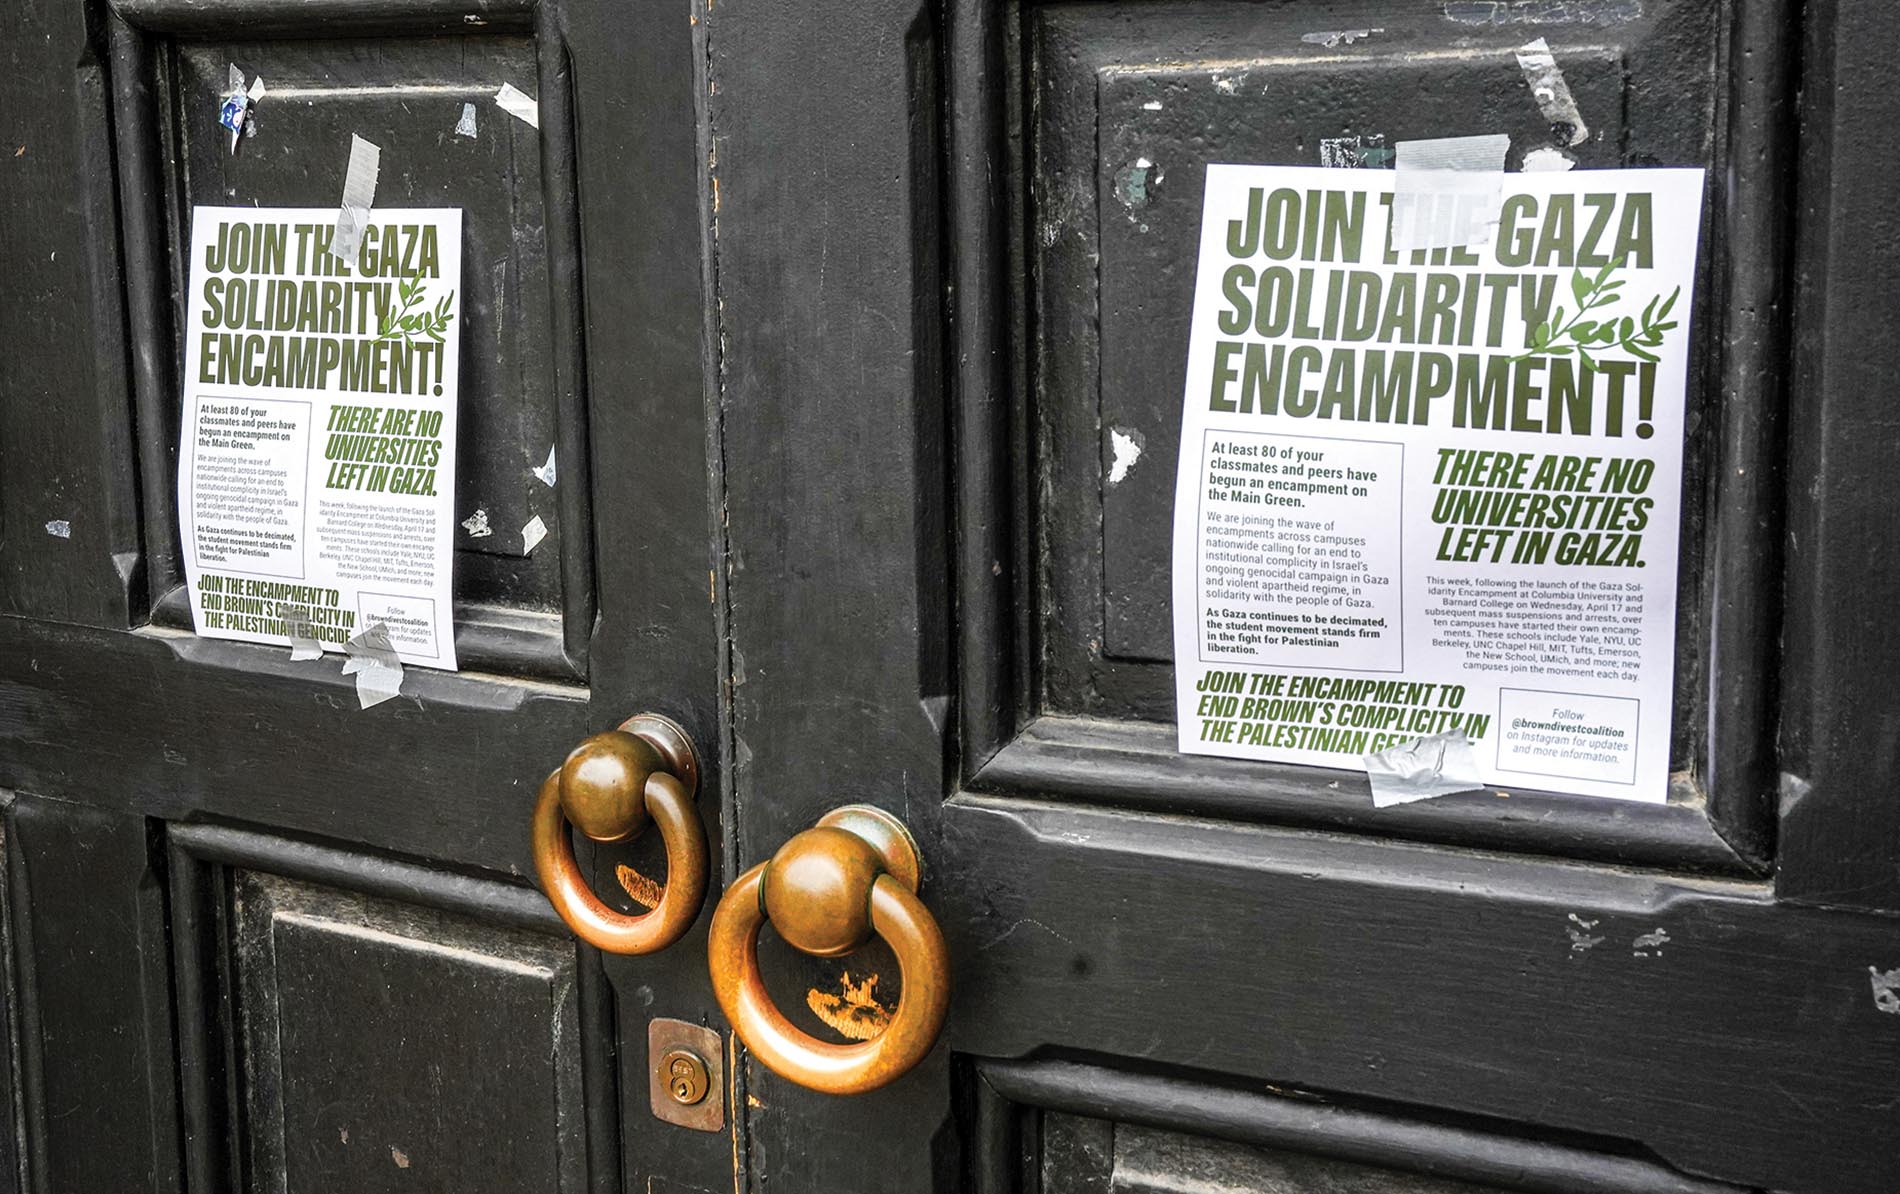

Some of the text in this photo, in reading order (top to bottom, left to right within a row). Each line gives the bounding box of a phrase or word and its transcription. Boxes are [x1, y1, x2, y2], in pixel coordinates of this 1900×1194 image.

[1226, 187, 1366, 265] JOIN
[1495, 192, 1654, 269] GAZA
[206, 222, 288, 274] JOIN
[358, 224, 440, 279] GAZA
[202, 278, 392, 335] SOLIDARITY
[1218, 264, 1558, 349] SOLIDARITY
[199, 333, 444, 396] ENCAMPMENT!
[1209, 341, 1657, 440] ENCAMPMENT!
[199, 415, 296, 430] classmates and peers have
[200, 404, 267, 418] At least 80 of your
[327, 405, 443, 438] THERE ARE NO
[198, 438, 255, 450] the Main Green.
[199, 426, 290, 441] begun an encampment on
[325, 434, 442, 467] UNIVERSITIES
[1211, 441, 1324, 465] At least 80 of your
[326, 462, 437, 496] LEFT IN GAZA.
[1210, 457, 1377, 482] classmates and peers have
[1433, 448, 1655, 494] THERE ARE NO
[1209, 472, 1367, 497] begun an encampment on
[1208, 488, 1305, 508] the Main Green.
[1207, 511, 1334, 531] We are joining the wave of
[1431, 489, 1654, 531] UNIVERSITIES
[1206, 526, 1366, 546] encampments across campuses
[1436, 527, 1646, 568] LEFT IN GAZA.
[1206, 539, 1361, 558] nationwide calling for an end to
[1205, 552, 1368, 572] institutional complicity in Israel's
[1205, 564, 1389, 586] ongoing genocidal campaign in Gaza
[198, 574, 339, 607] JOIN THE ENCAMPMENT TO
[1205, 576, 1361, 599] and violent apartheid regime, in
[1206, 588, 1374, 608] solidarity with the people of Gaza.
[1428, 587, 1456, 600] idarity
[1458, 587, 1517, 601] Encampment
[1531, 590, 1575, 600] Columbia
[1577, 592, 1623, 605] University
[1625, 594, 1643, 603] and
[201, 593, 222, 610] END
[224, 596, 273, 616] BROWN'S
[343, 611, 355, 628] IN
[1206, 607, 1387, 629] As Gaza continues to be decimated,
[1424, 608, 1476, 621] subsequent
[1505, 612, 1563, 624] suspensions
[1565, 613, 1582, 621] and
[1584, 614, 1619, 623] arrests,
[1621, 616, 1642, 624] over
[205, 612, 224, 628] THE
[226, 614, 292, 637] PALESTINIAN
[1206, 619, 1380, 638] the student movement stands firm
[1207, 631, 1339, 648] in the fight for Palestinian
[1207, 642, 1258, 654] liberation.
[1196, 670, 1465, 709] JOIN THE ENCAMPMENT TO
[1197, 694, 1490, 740] END BROWN'S COMPLICITY IN
[1552, 708, 1584, 720] Follow
[1200, 720, 1236, 743] THE
[1237, 723, 1370, 754] PALESTINIAN
[1512, 718, 1624, 737] @browndivestcoalition
[1506, 731, 1628, 751] on Instagram for updates
[1512, 745, 1620, 763] and more information.
